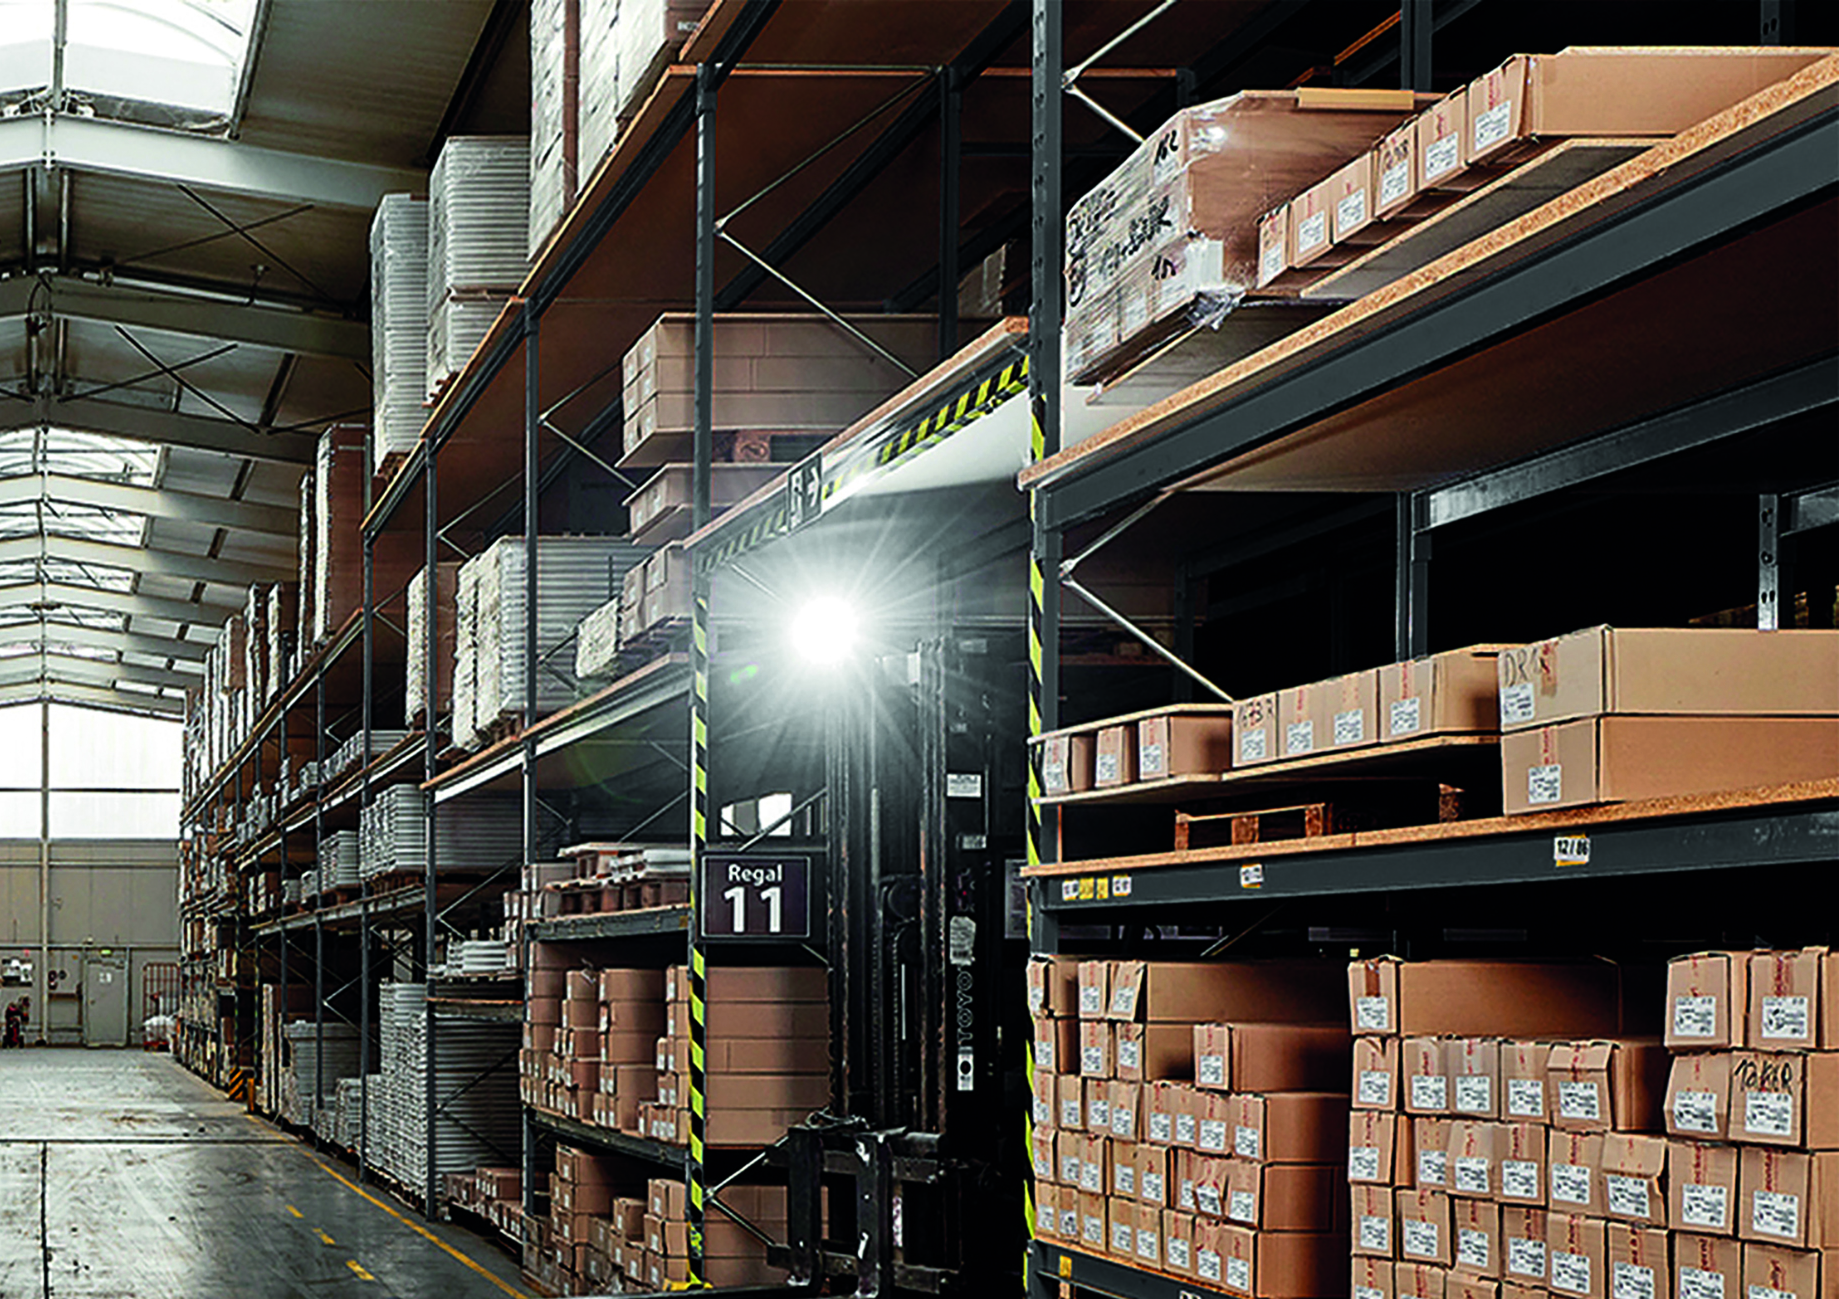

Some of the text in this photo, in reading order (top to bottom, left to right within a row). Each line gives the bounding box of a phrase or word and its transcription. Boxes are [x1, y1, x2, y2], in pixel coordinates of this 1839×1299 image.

[727, 862, 783, 886] Regal
[723, 886, 782, 933] 11
[956, 967, 974, 1046] TOYO
